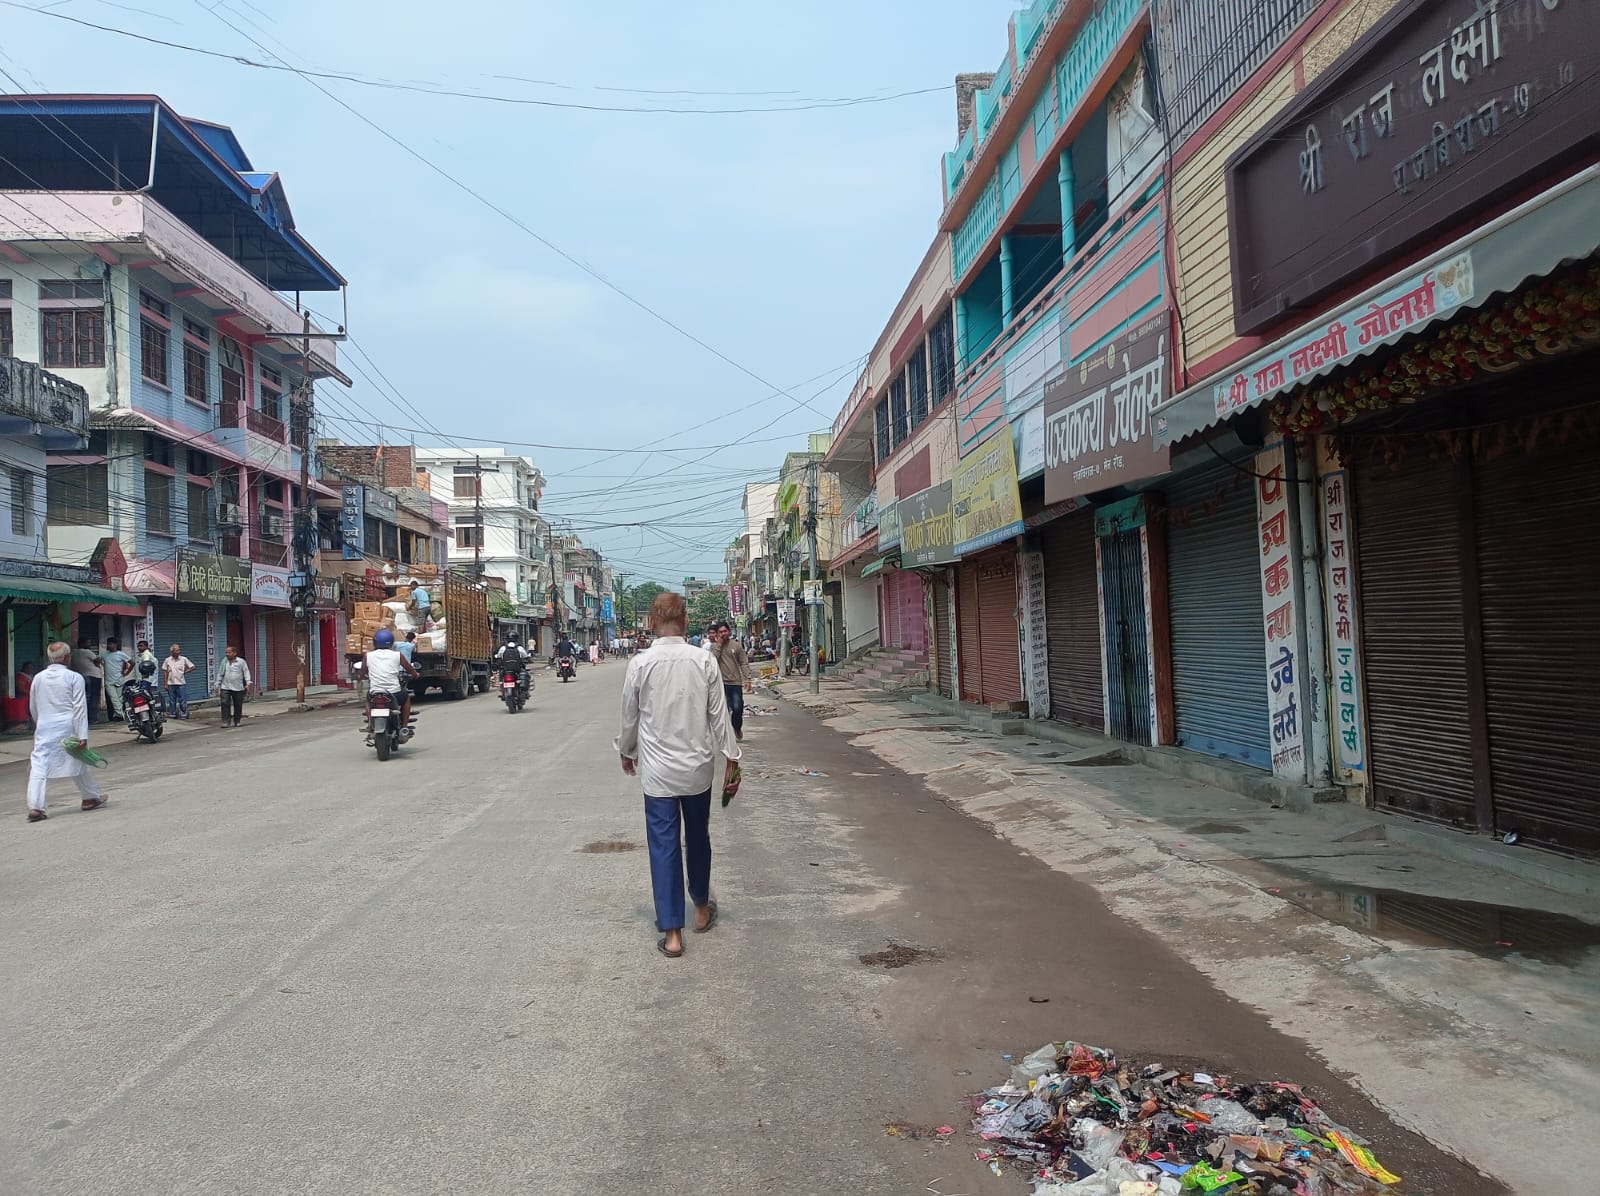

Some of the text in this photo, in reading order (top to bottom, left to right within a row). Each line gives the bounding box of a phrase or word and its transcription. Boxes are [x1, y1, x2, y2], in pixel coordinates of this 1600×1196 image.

[1298, 123, 1325, 195] श्री
[1342, 82, 1395, 164] राज
[1109, 333, 1165, 448] ज्वेलर्स
[1229, 373, 1249, 408] श्री
[1253, 359, 1286, 396] राज
[1354, 271, 1437, 346] ज्वेलर्स
[232, 571, 251, 596] ज्वेलर्स
